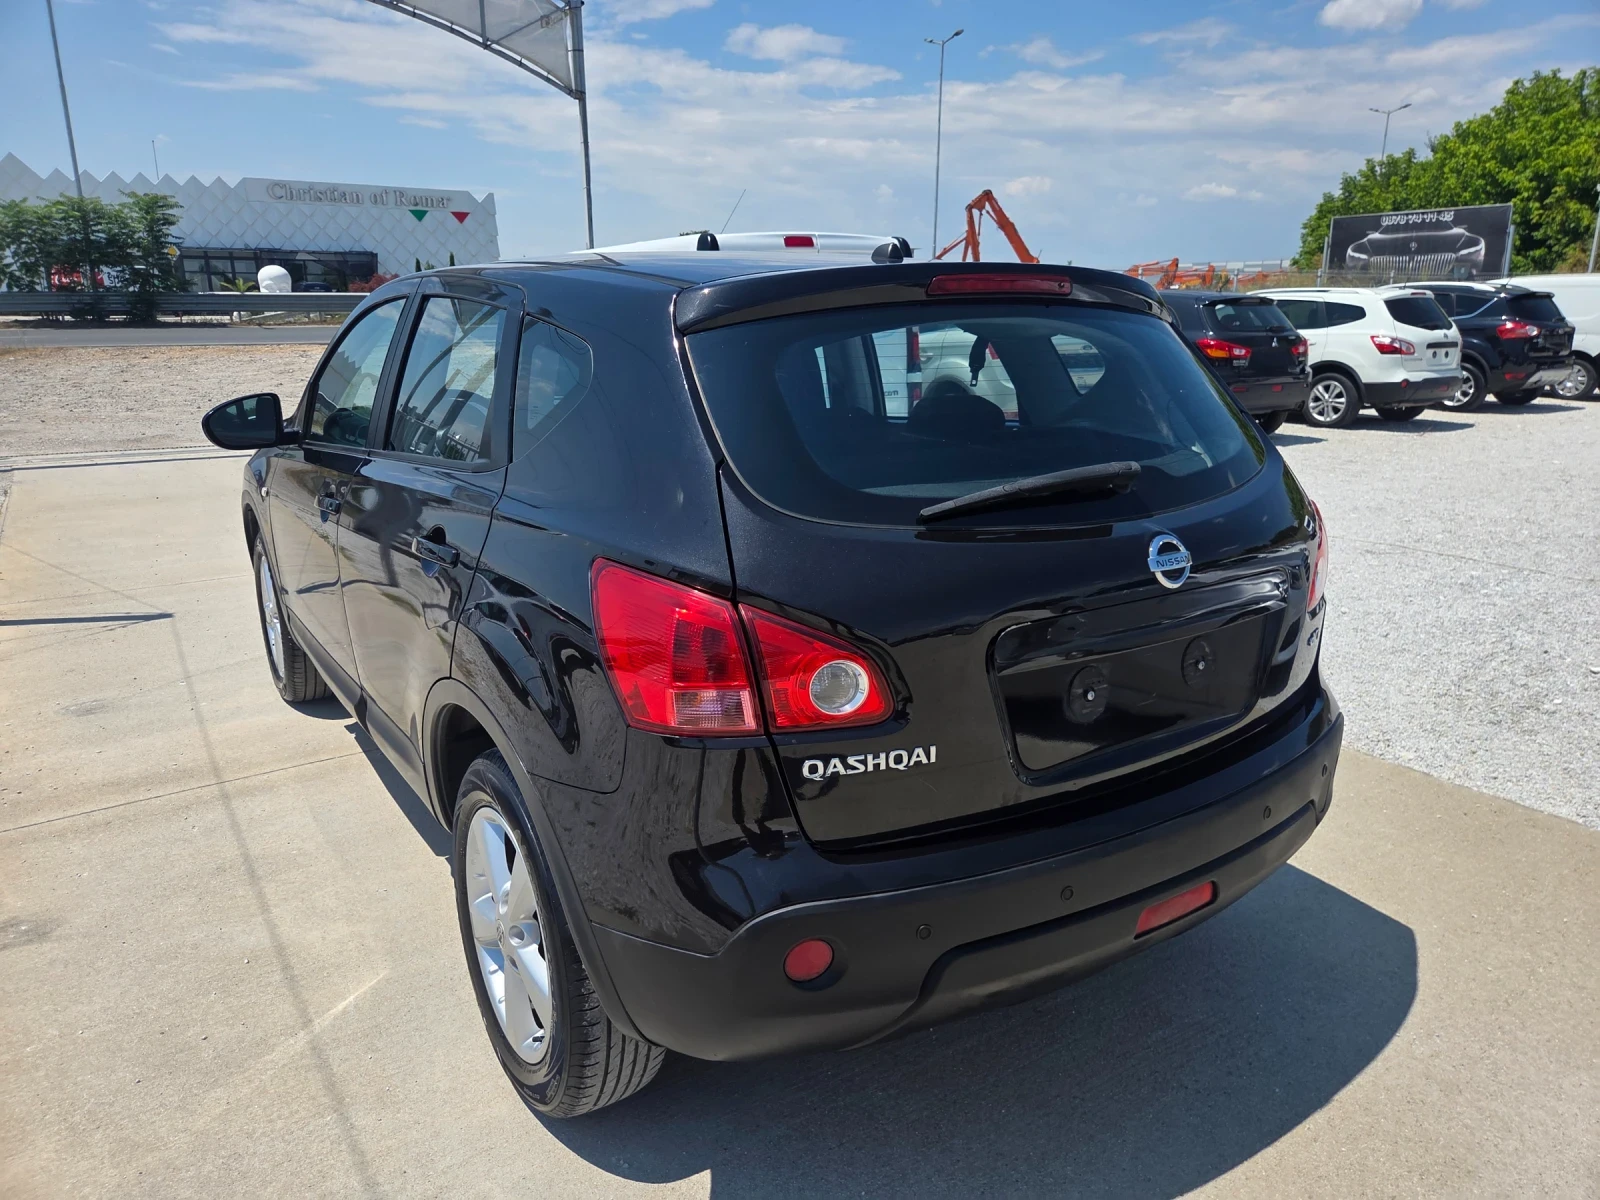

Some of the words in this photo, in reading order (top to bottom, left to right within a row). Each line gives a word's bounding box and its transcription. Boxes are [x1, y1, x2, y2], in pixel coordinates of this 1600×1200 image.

[267, 182, 364, 205] Christian
[370, 189, 389, 206] of
[395, 190, 450, 209] Roma
[1156, 554, 1189, 568] NISSAN
[802, 745, 937, 781] QASHQAI
